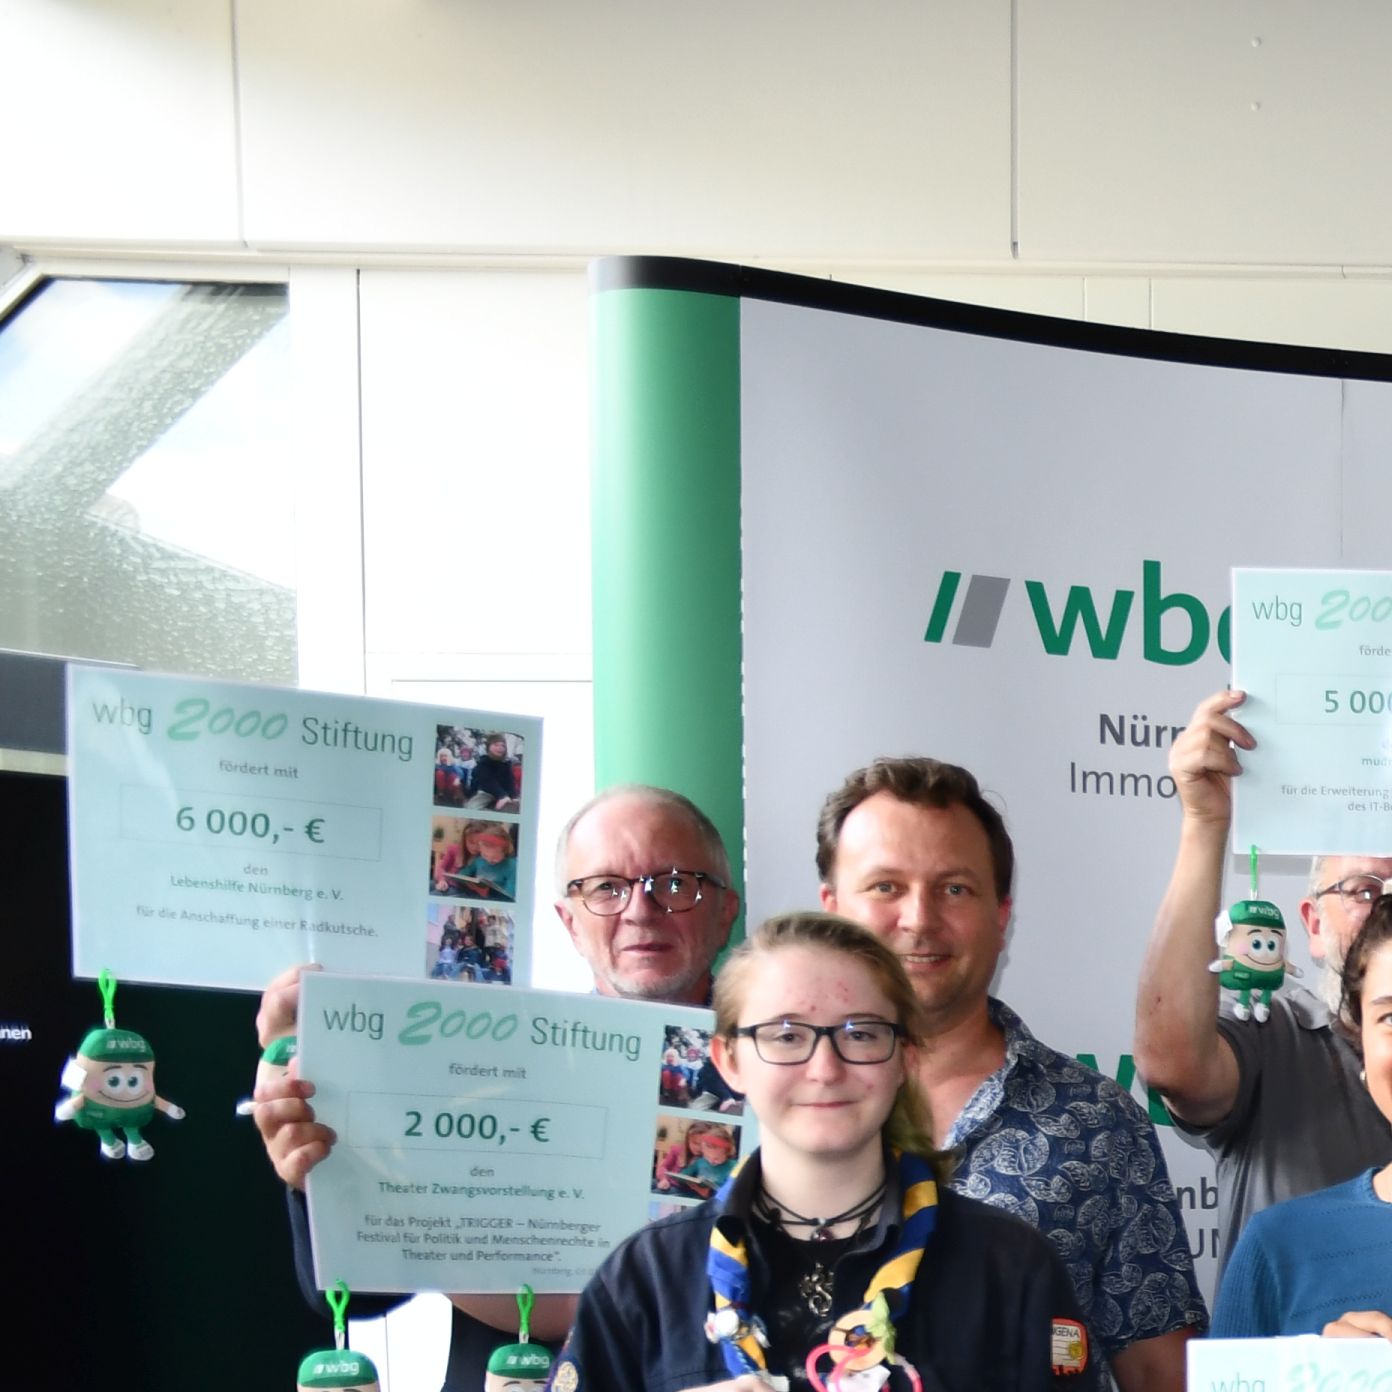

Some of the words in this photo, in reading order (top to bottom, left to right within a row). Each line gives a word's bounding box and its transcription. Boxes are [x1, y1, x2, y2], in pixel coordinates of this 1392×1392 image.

[1025, 559, 1231, 668] wb
[1252, 595, 1303, 626] wbg
[1325, 690, 1339, 713] 5
[91, 697, 152, 734] wbg
[166, 697, 287, 741] 2000
[301, 717, 414, 762] Stiftung
[1321, 786, 1389, 799] Erweiterung
[1348, 801, 1366, 811] des
[176, 806, 195, 831] 6
[206, 809, 294, 844] 000,-
[305, 818, 325, 843] €
[323, 1004, 384, 1040] wbg
[398, 1000, 519, 1046] 2000
[530, 1017, 642, 1061] Stiftung
[404, 1111, 422, 1136] 2
[435, 1113, 520, 1145] 000,-
[530, 1118, 550, 1142] €
